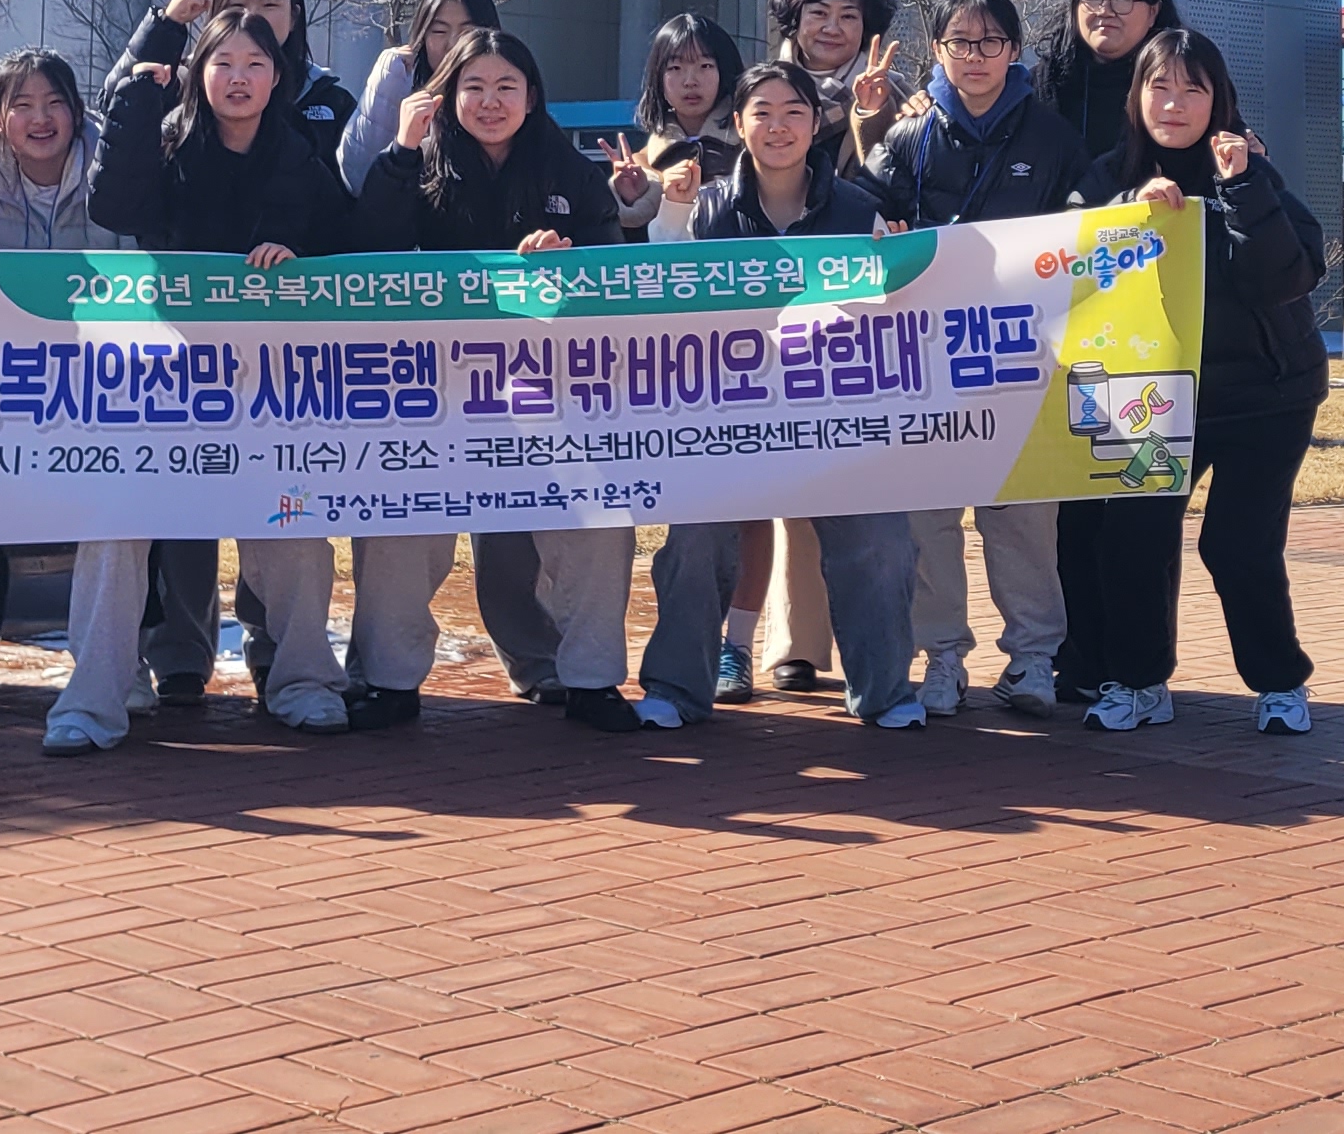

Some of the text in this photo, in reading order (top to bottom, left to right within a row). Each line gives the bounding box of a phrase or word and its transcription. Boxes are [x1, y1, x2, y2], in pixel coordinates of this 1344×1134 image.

[1097, 227, 1141, 243] 경남교육
[66, 255, 884, 307] 2026년 교육복지안전망 한국청소년활동진흥원 연계
[1034, 236, 1165, 289] 아이좋아
[250, 339, 439, 422] 사제동행
[568, 335, 616, 413] 밖
[628, 328, 768, 408] 바이오
[944, 304, 1041, 388] 캠프
[48, 446, 125, 474] 2026.
[135, 446, 159, 474] 2.
[169, 443, 240, 475] 9.(월)
[378, 439, 439, 471] 장소
[464, 415, 892, 469] 국립청소년바이오생명센터(전북
[899, 408, 996, 445] 김제시)
[318, 480, 662, 522] 경상남도남해교육지원청
